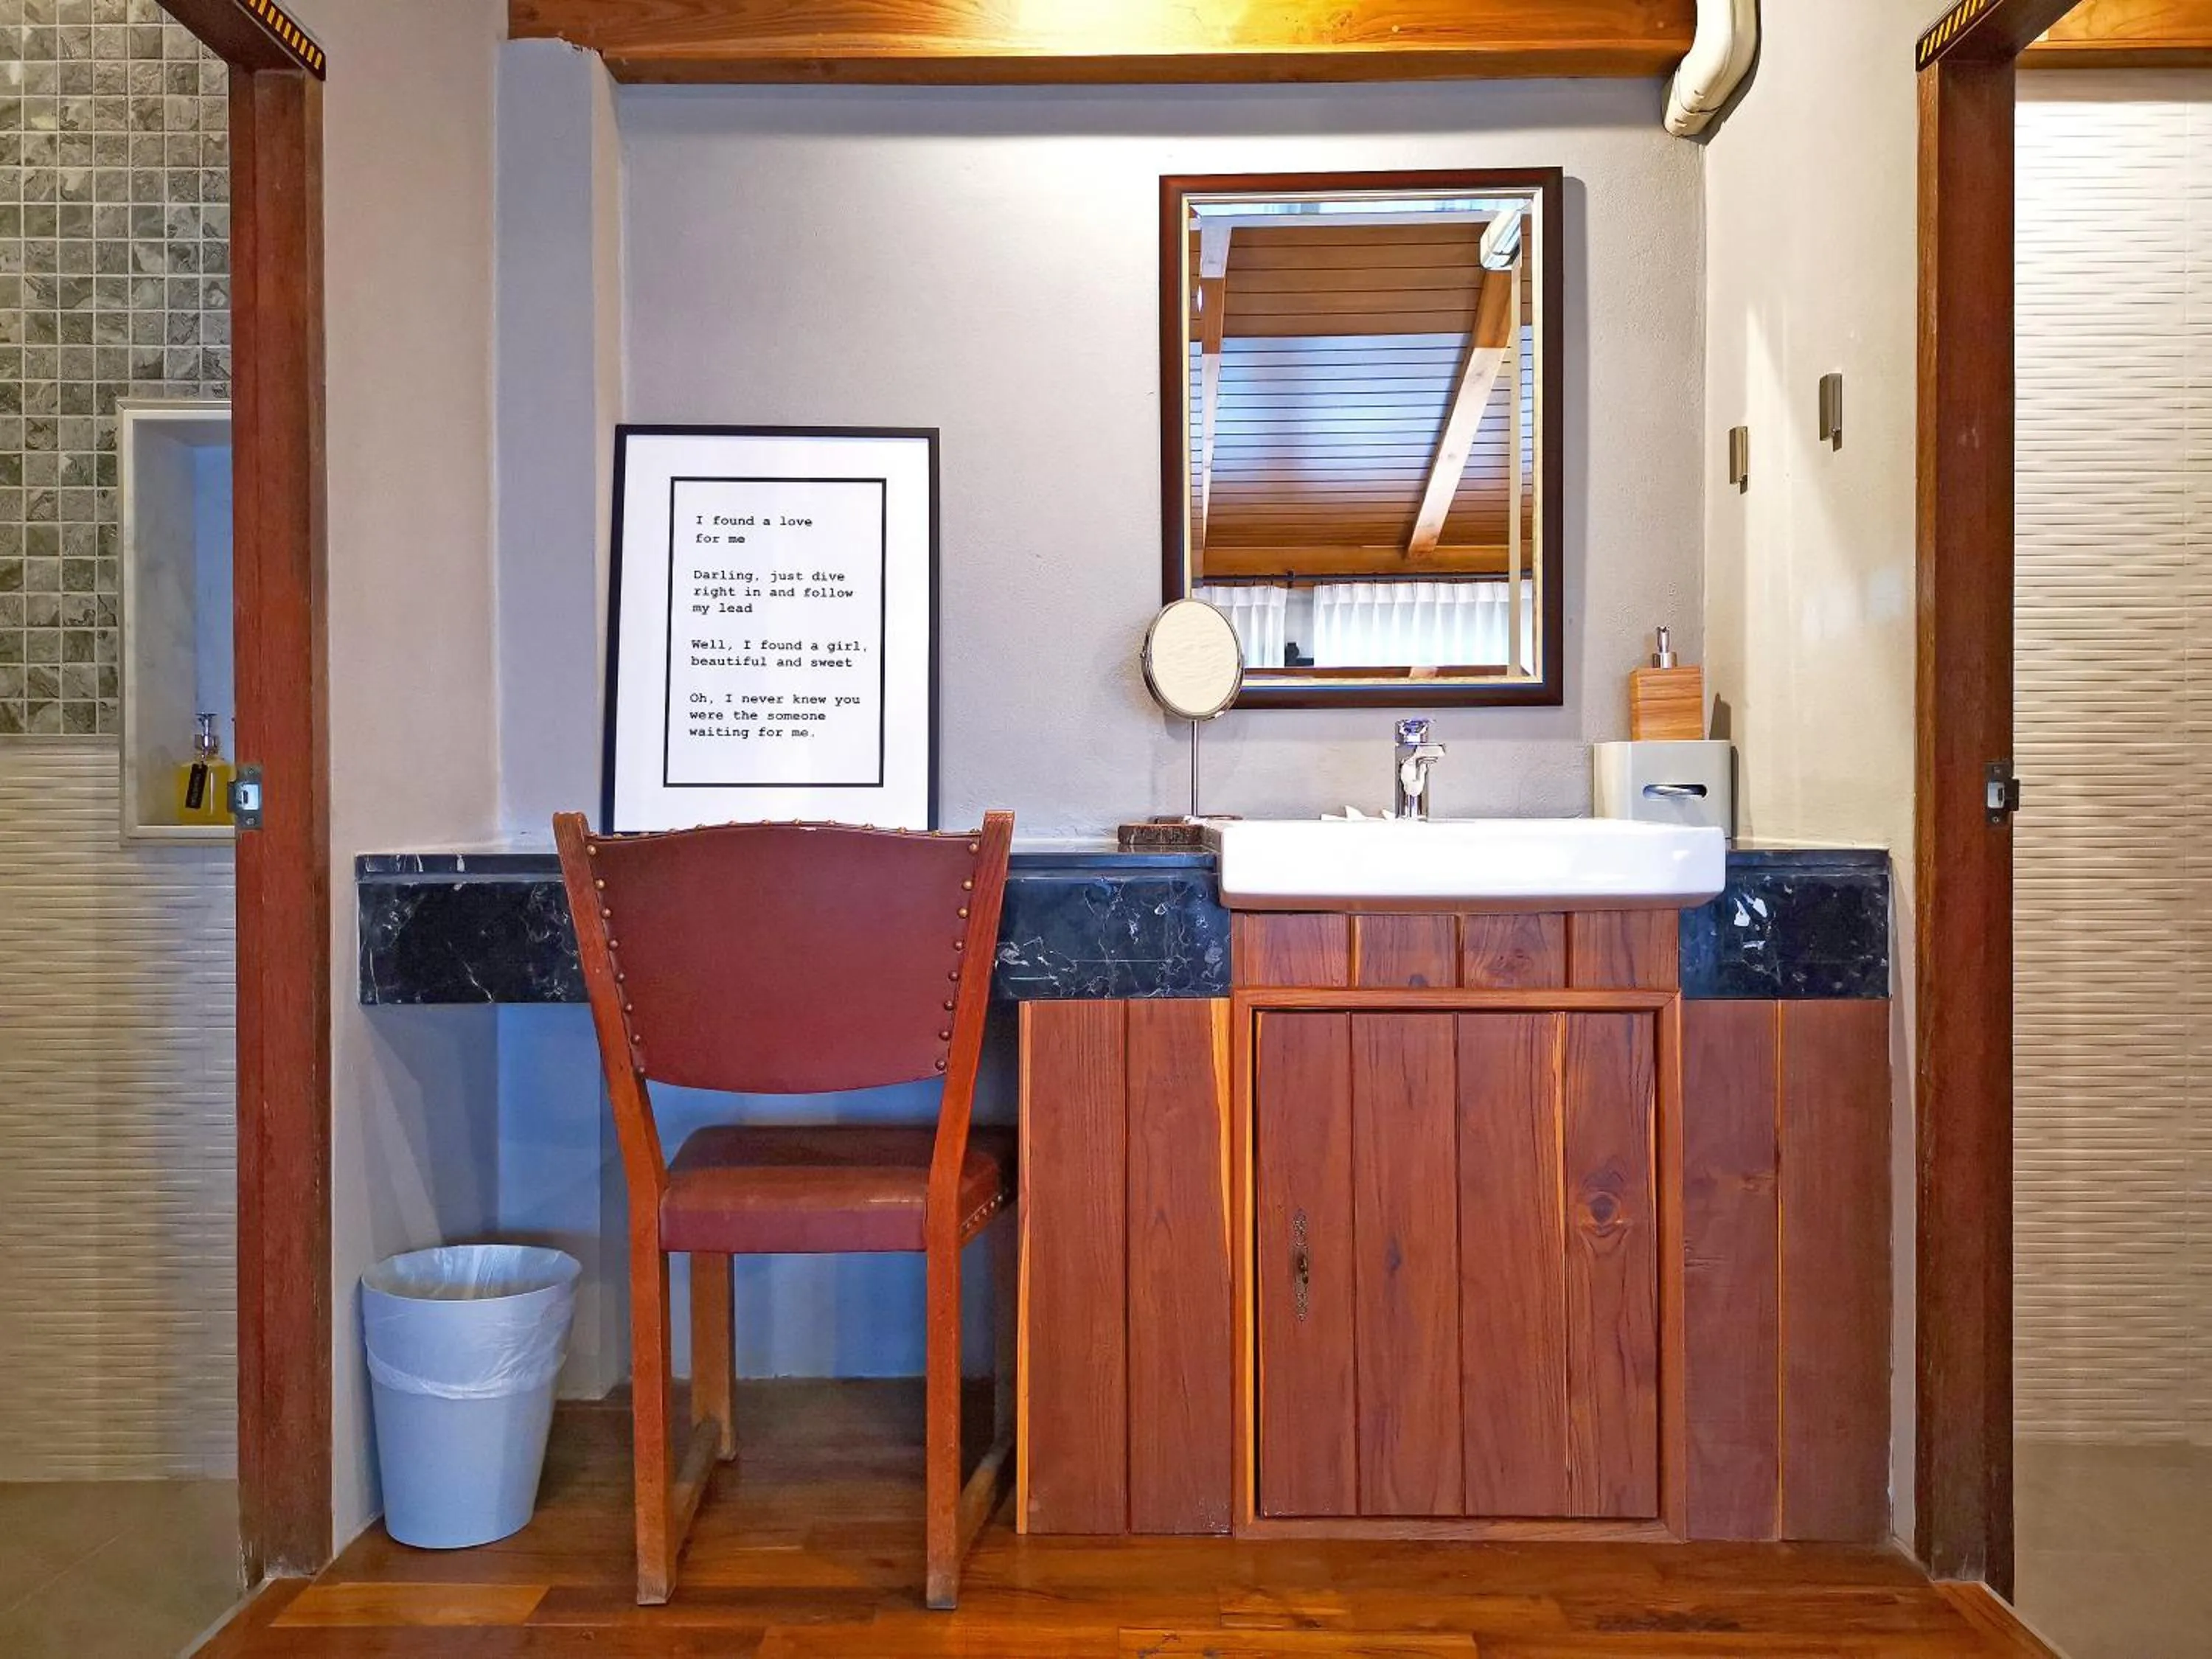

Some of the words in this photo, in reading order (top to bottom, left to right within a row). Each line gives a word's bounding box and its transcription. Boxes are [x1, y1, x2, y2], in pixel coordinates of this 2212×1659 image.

[697, 516, 703, 524] I
[714, 515, 754, 525] found
[780, 516, 813, 526] love
[696, 533, 720, 543] for
[771, 571, 802, 582] just
[812, 571, 844, 581] dive
[694, 586, 735, 599] right
[745, 587, 761, 596] in
[770, 588, 794, 597] and
[804, 588, 853, 597] follow
[692, 605, 710, 615] my
[719, 603, 753, 613] lead
[692, 640, 732, 650] Well,
[744, 640, 751, 649] I
[761, 640, 801, 650] found
[691, 656, 767, 667] beautiful
[776, 658, 801, 667] and
[811, 658, 852, 667] sweet
[690, 693, 713, 704] Oh,
[726, 694, 731, 703] I
[793, 695, 826, 703] knew
[835, 697, 860, 706] you
[734, 711, 758, 720] the
[689, 727, 749, 739] waiting
[759, 727, 783, 737] for
